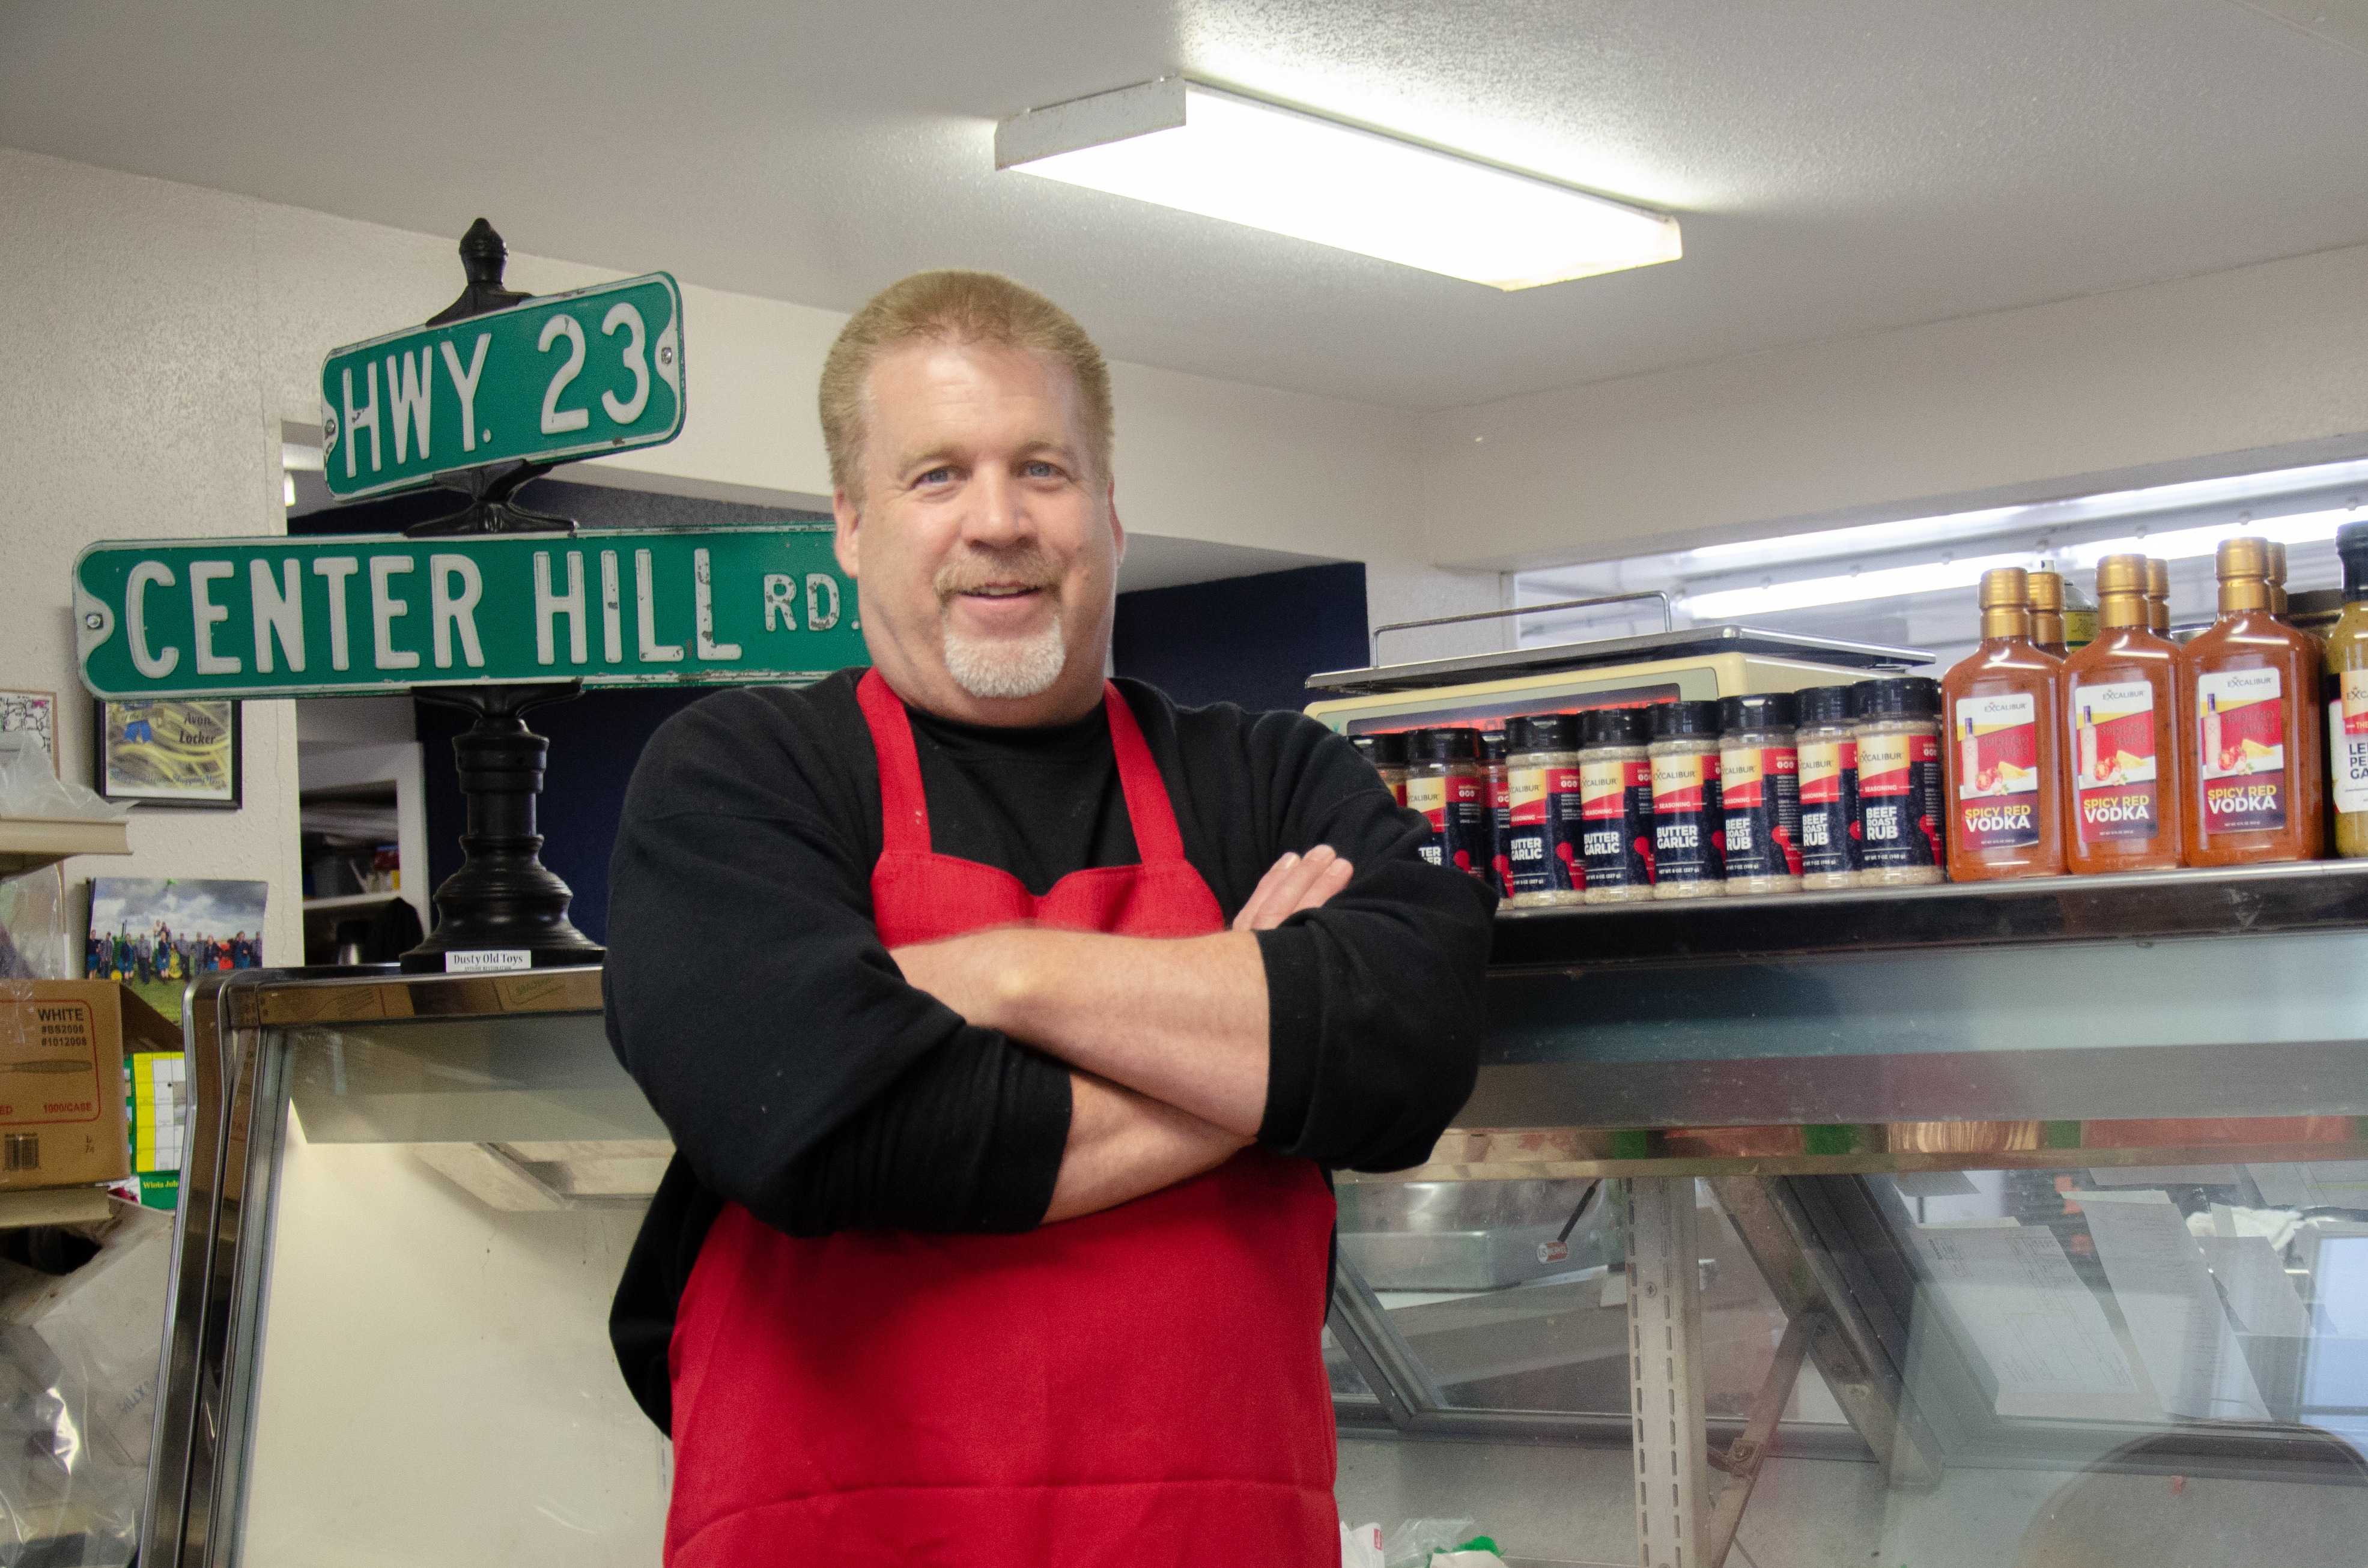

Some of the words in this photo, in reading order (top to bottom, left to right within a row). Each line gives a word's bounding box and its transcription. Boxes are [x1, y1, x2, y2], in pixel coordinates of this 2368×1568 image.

[342, 333, 491, 477] HWY.
[537, 303, 647, 435] 23
[126, 553, 485, 678] CENTER
[533, 548, 742, 664] HILL
[764, 574, 860, 632] RD.
[2227, 677, 2271, 688] EXCALIBUR
[2103, 691, 2143, 701] EXCALIBUR
[2347, 691, 2368, 701] EXC
[1984, 703, 2026, 712] EXCALIBUR
[184, 712, 212, 725] Avon
[180, 730, 216, 744] Locker
[2349, 743, 2368, 755] LE
[2350, 756, 2368, 767] PE
[2350, 768, 2368, 780] GA
[2208, 788, 2244, 800] SPICY
[2248, 785, 2277, 797] RED
[2084, 797, 2119, 809] SPICY
[2122, 795, 2149, 807] RED
[2208, 795, 2276, 814] VODKA
[1866, 806, 1897, 819] BEEF
[1965, 807, 2001, 819] SPICY
[2004, 805, 2030, 816] RED
[2084, 805, 2149, 823] VODKA
[1725, 818, 1750, 830] BEEF
[1802, 813, 1827, 825] BEEF
[1866, 817, 1897, 827] ROAST
[1966, 815, 2031, 832] VODKA
[1657, 825, 1697, 838] BUTTER
[1726, 828, 1750, 838] ROAST
[1803, 823, 1828, 833] ROAST
[1867, 826, 1898, 841] RUB
[1511, 838, 1541, 849] BUTTER
[1583, 831, 1619, 844] BUTTER
[1657, 836, 1699, 849] GARLIC
[1726, 837, 1752, 851] RUB
[1803, 832, 1829, 847] RUB
[1511, 848, 1543, 861] GARLIC
[1584, 843, 1620, 856] GARLIC
[454, 954, 480, 964] Dusty
[483, 953, 499, 963] Old
[500, 953, 523, 966] Toys
[38, 1009, 83, 1021] WHITE
[44, 1101, 93, 1113] 1000/CASE
